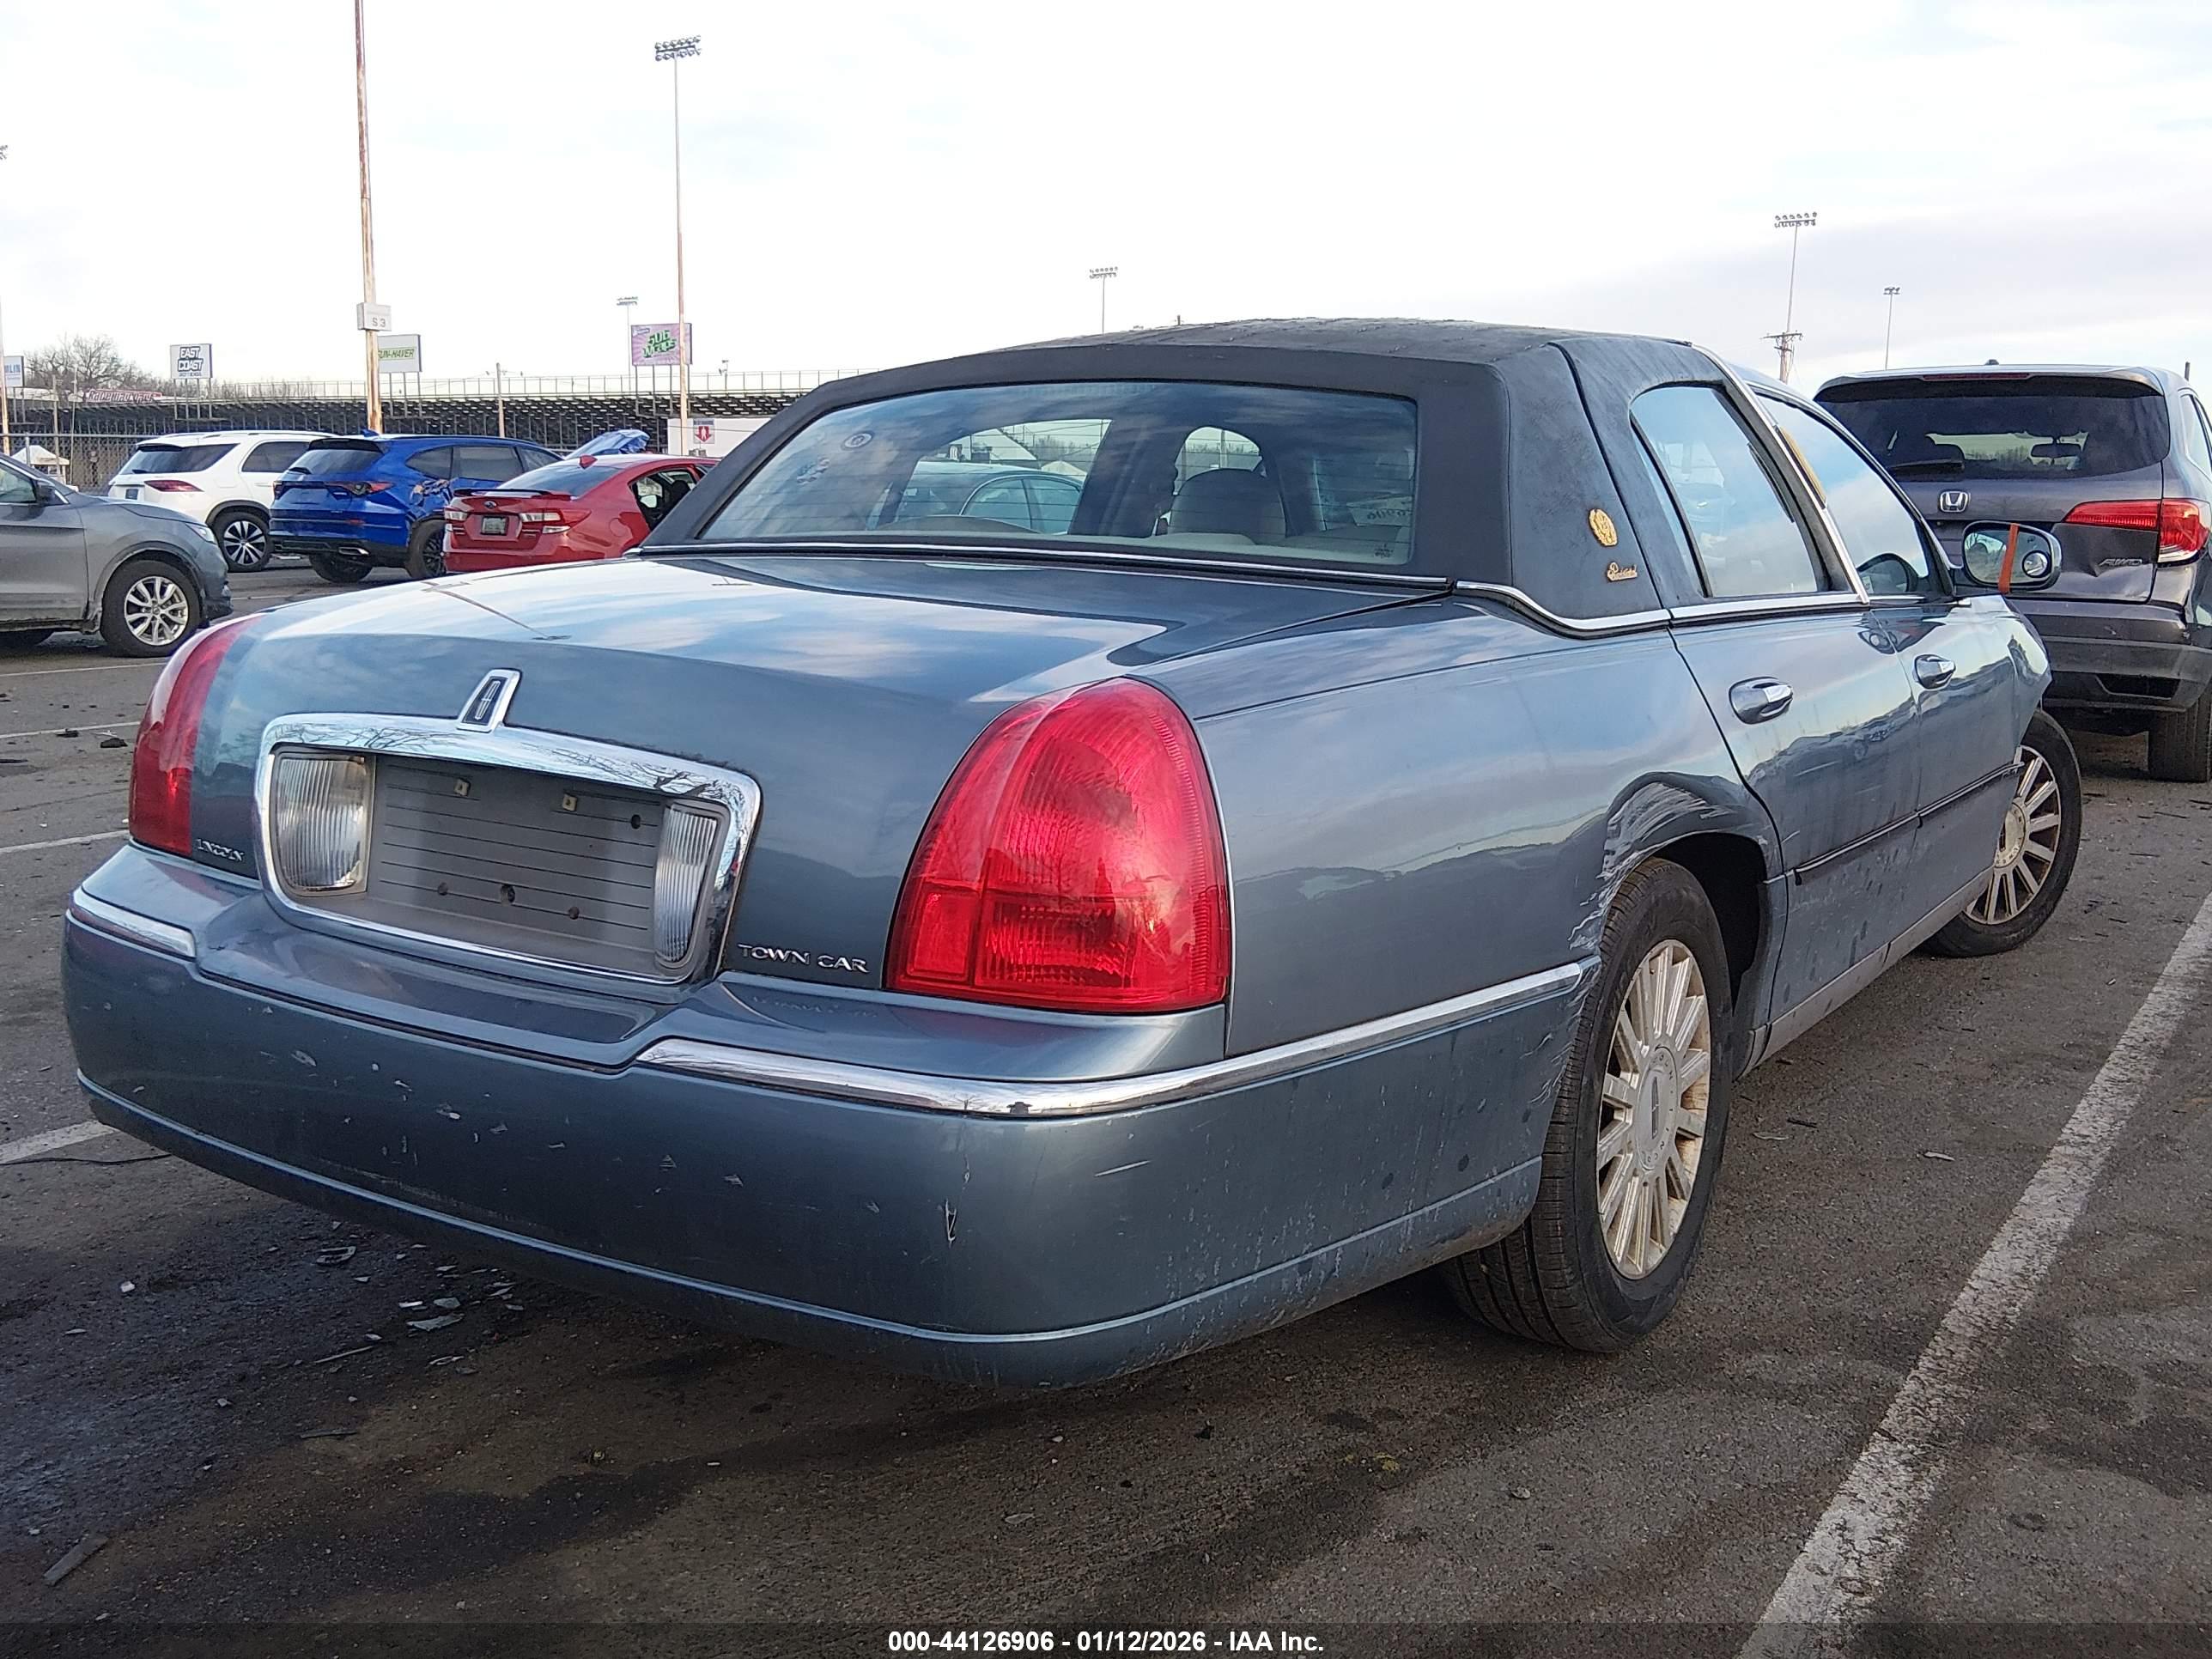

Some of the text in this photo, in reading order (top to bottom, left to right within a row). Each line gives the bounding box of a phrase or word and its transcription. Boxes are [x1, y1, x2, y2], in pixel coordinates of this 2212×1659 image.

[179, 346, 200, 359] EAST
[178, 358, 204, 372] COAST
[2099, 558, 2143, 567] AWD
[738, 944, 869, 973] TOWN CAR
